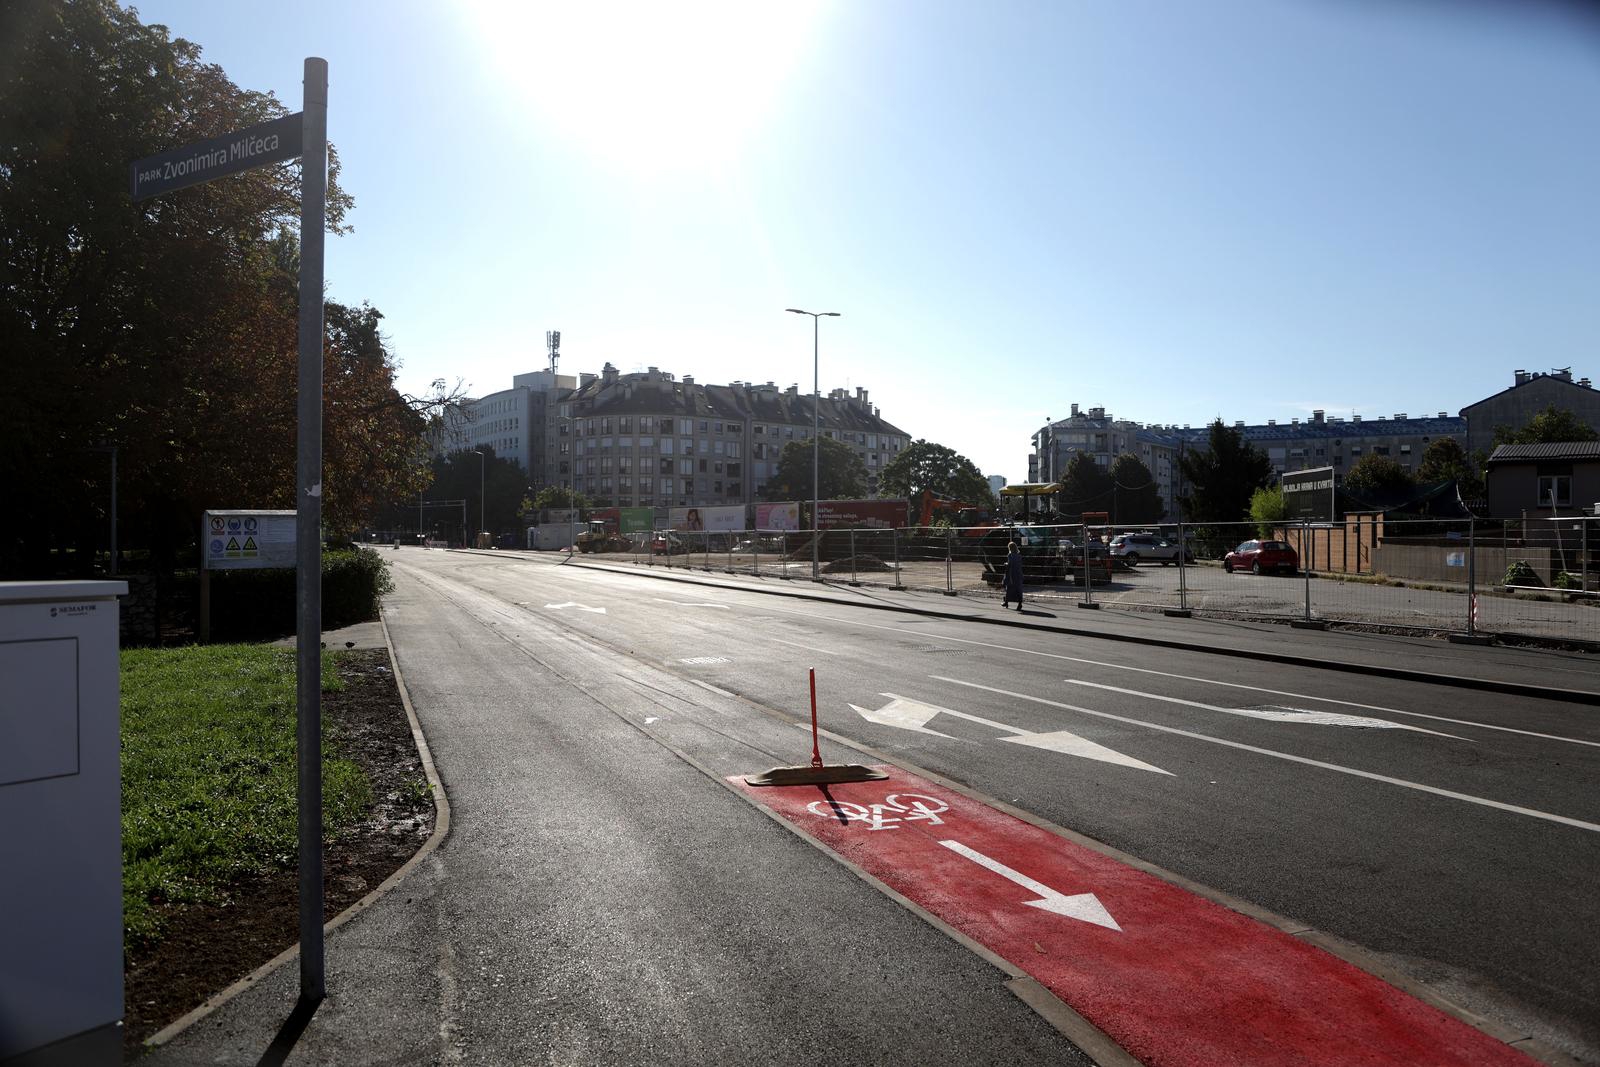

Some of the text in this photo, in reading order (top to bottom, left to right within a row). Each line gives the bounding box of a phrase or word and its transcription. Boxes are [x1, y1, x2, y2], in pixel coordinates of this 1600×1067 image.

[139, 134, 279, 183] PARK Zvonimira Milčeca
